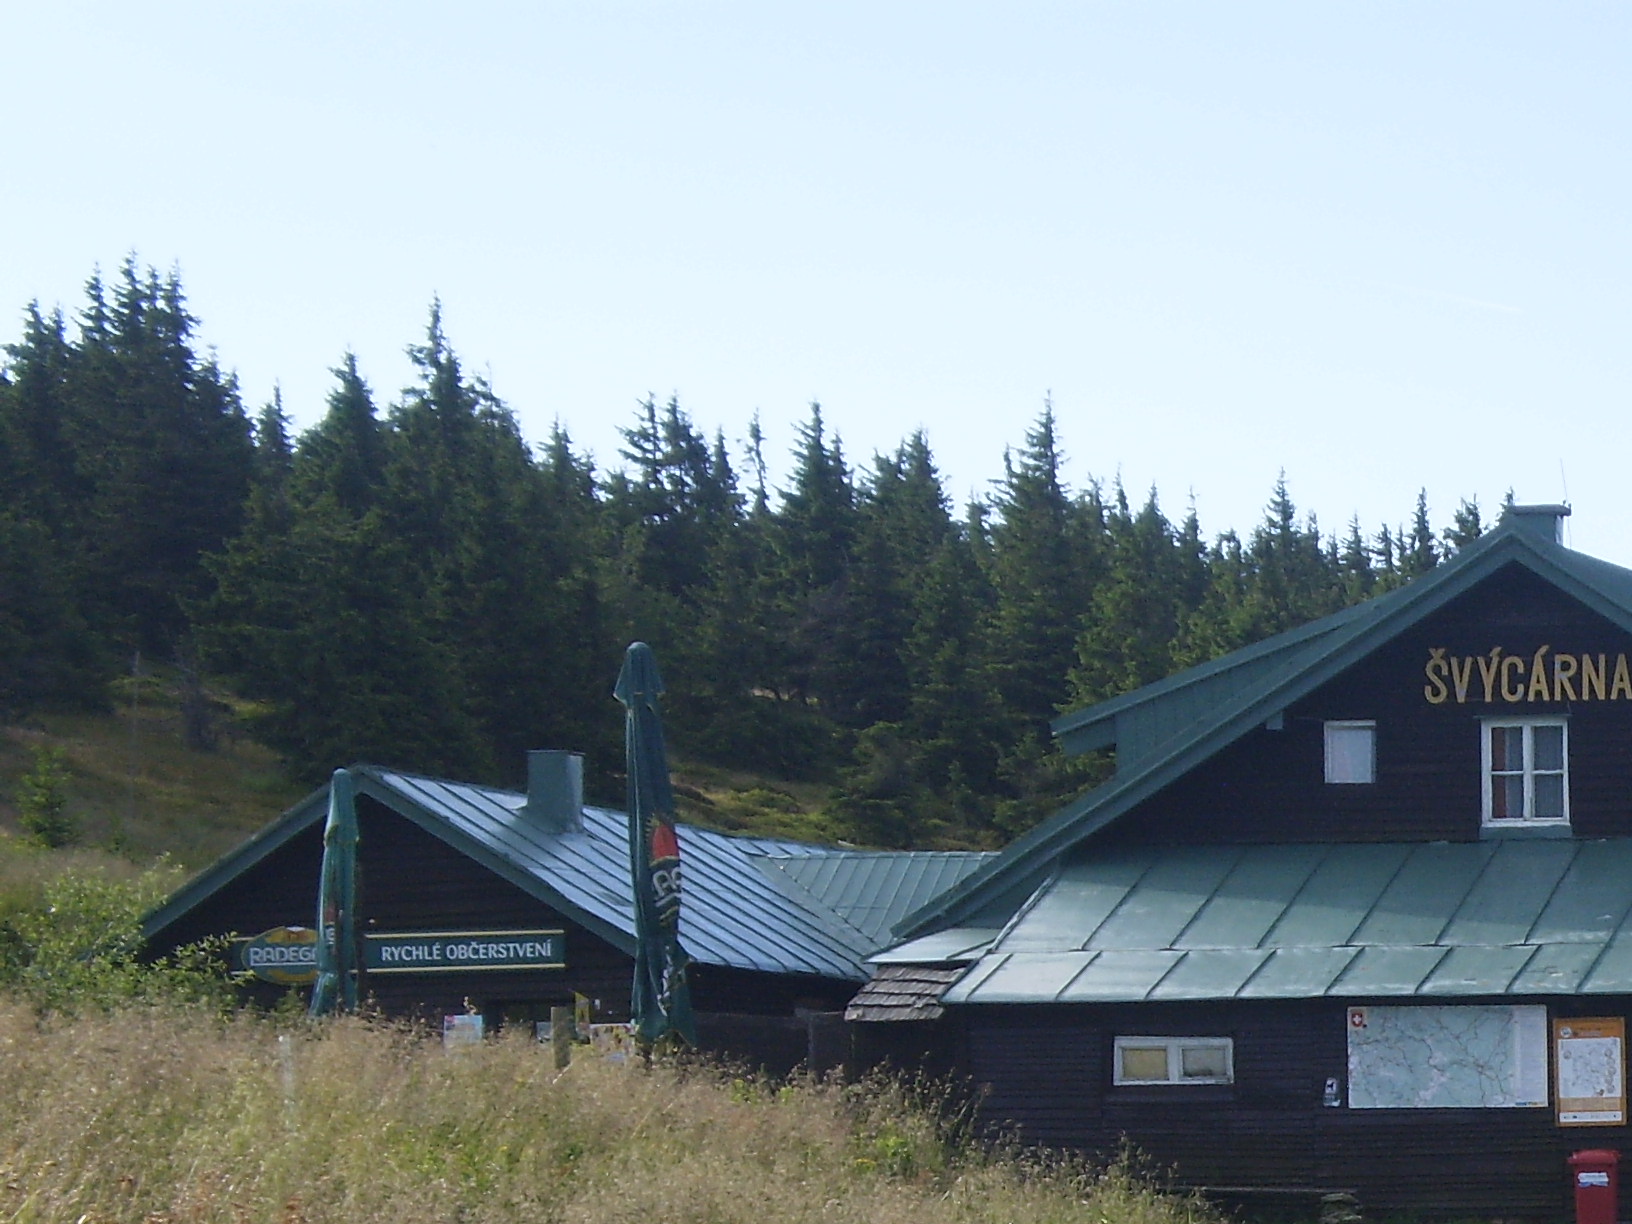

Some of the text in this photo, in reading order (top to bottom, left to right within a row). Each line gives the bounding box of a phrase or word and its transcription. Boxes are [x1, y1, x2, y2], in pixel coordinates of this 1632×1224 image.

[250, 946, 317, 964] RADEG
[381, 939, 552, 961] RYCHLÉ OBČERSTVENÍ
